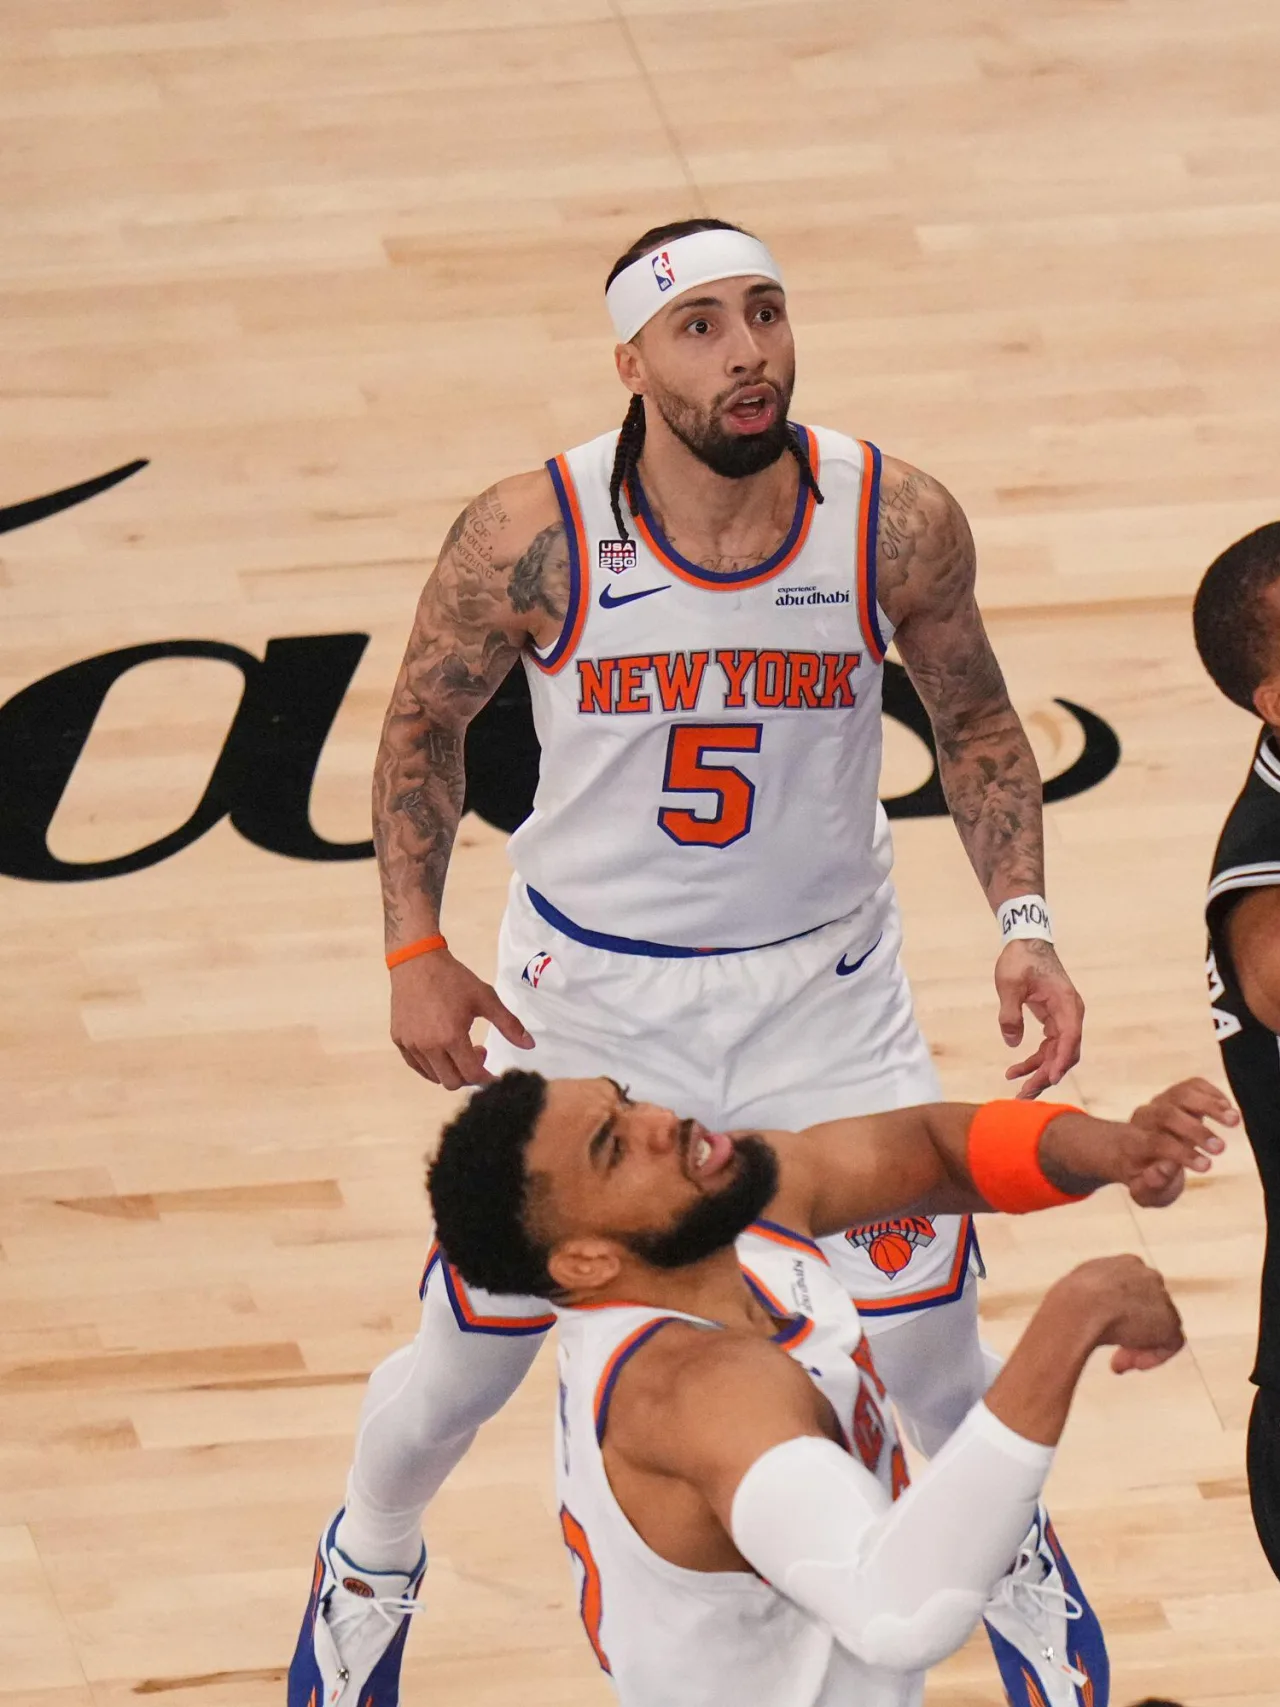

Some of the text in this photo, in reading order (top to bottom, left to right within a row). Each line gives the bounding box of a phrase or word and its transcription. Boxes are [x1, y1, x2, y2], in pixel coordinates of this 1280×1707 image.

[601, 542, 634, 551] USA
[600, 557, 636, 568] 250
[777, 585, 817, 594] experience
[775, 590, 850, 606] abu dhabi
[576, 648, 863, 714] NEW YORK
[657, 723, 763, 849] 5
